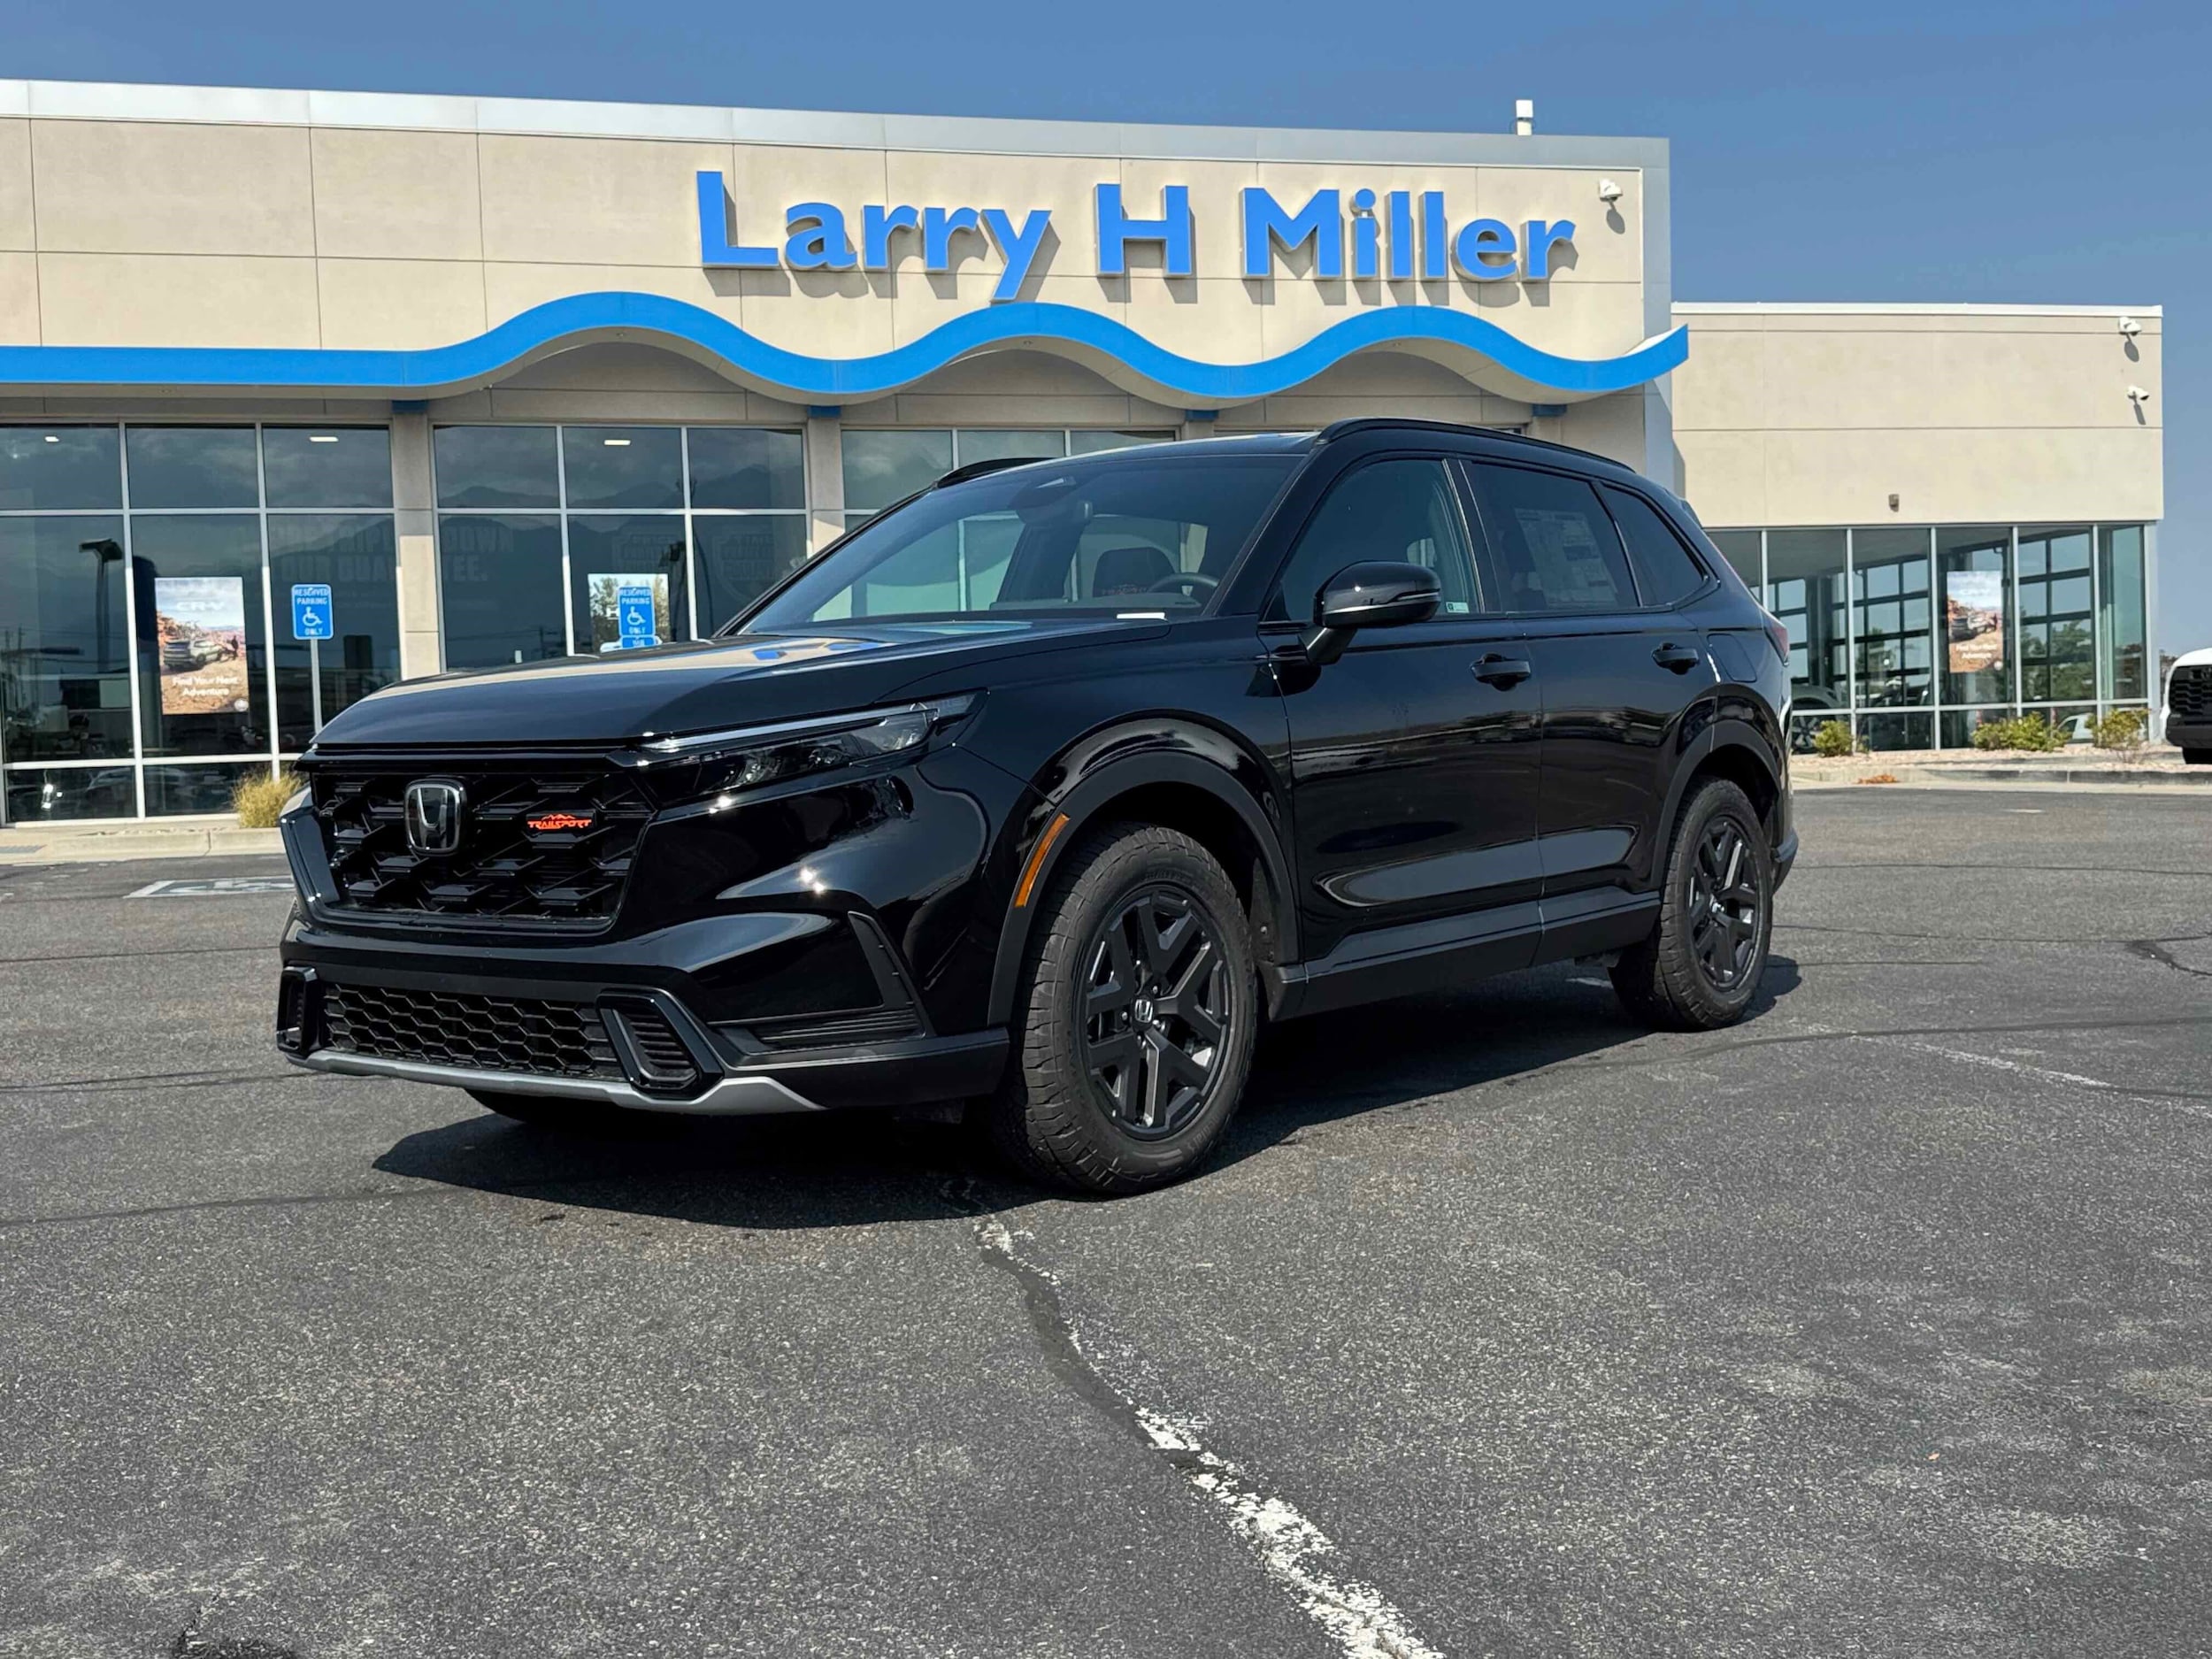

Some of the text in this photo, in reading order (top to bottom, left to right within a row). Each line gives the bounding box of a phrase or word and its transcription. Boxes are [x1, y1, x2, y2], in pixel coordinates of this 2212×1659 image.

[696, 171, 1577, 302] Larry H Miller
[173, 676, 192, 685] Find
[182, 687, 230, 696] Adventure
[527, 818, 592, 830] TRAILSPORT
